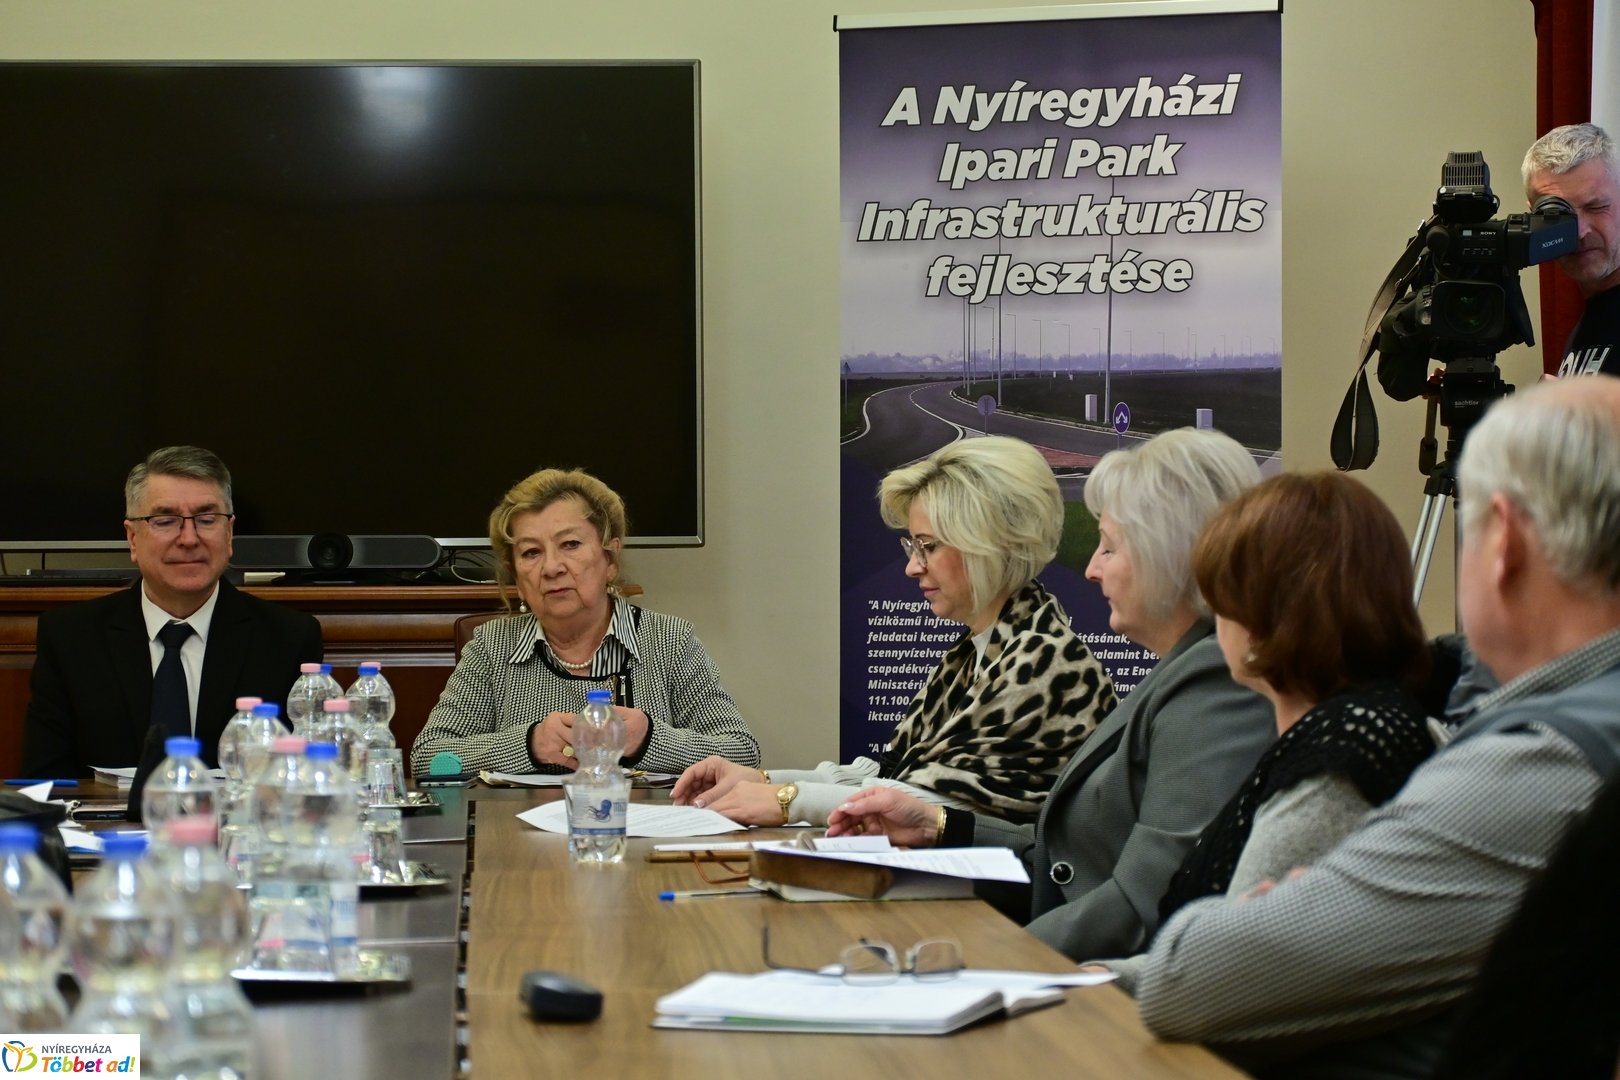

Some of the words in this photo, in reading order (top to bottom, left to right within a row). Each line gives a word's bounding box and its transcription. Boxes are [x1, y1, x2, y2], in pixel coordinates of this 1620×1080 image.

[880, 86, 921, 127] A
[932, 72, 1243, 132] Nyíregyházi
[938, 137, 1058, 190] Ipari
[1062, 133, 1185, 178] Park
[857, 189, 1267, 241] Infrastrukturális
[925, 249, 1193, 304] fejlesztése
[868, 616, 922, 626] víziközmű
[882, 599, 933, 613] Nyíregyh
[866, 632, 918, 644] feladatai
[1117, 667, 1129, 675] az
